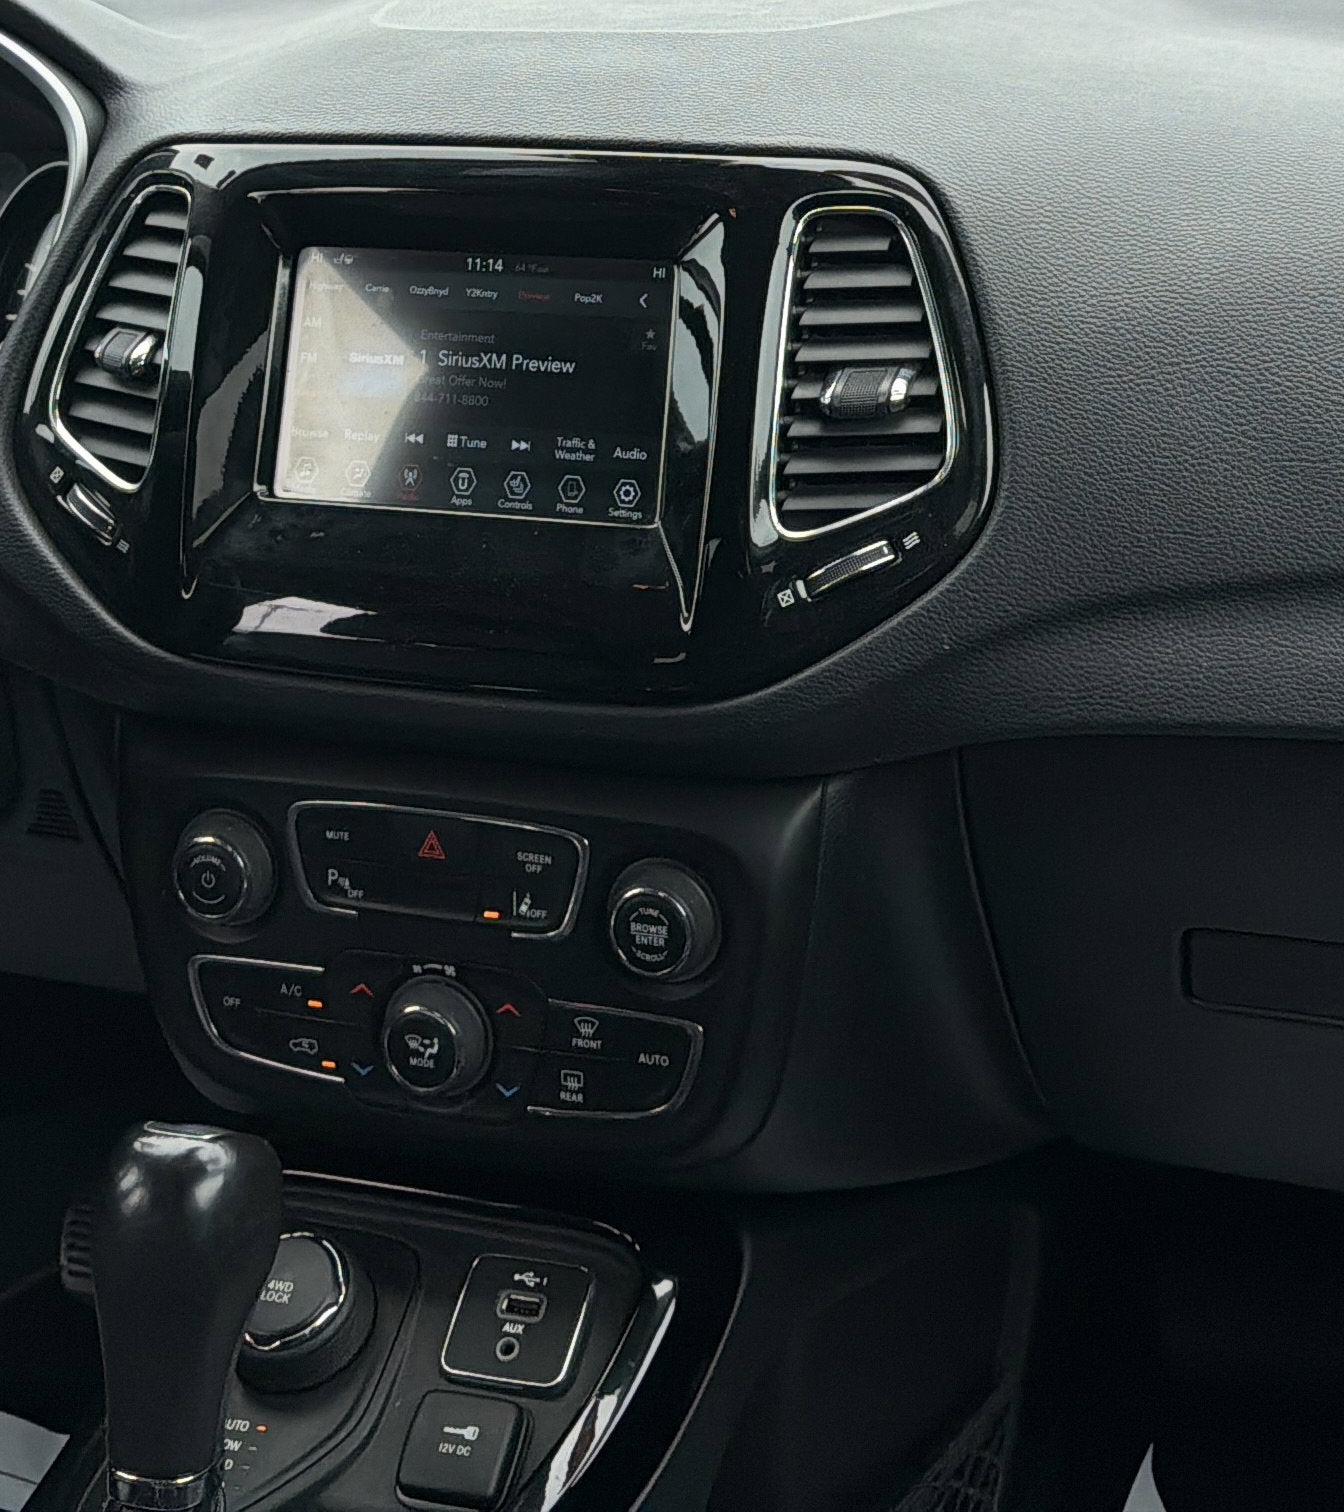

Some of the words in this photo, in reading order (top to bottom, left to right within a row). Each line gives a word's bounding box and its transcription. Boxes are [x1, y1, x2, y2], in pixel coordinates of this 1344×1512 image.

[466, 257, 504, 272] 11:14
[653, 267, 666, 279] HI
[574, 293, 603, 305] Pop2K
[303, 317, 322, 328] AM
[420, 329, 496, 344] Entertainment
[301, 352, 318, 363] FM
[348, 351, 405, 366] SiriusXM
[437, 350, 506, 369] SiriusXM
[512, 354, 576, 374] Preview
[448, 375, 476, 387] Offer
[344, 429, 380, 443] Replay
[460, 436, 488, 449] Tune
[556, 437, 586, 449] Traffic
[555, 450, 596, 462] Weather
[612, 447, 648, 461] Audio
[450, 496, 473, 507] Apps
[497, 498, 533, 511] Controls
[556, 503, 584, 514] Phone
[608, 507, 643, 521] Settings
[325, 830, 349, 842] MUTE
[516, 851, 552, 866] SCREEN
[524, 863, 543, 873] OFF
[348, 889, 364, 899] OFF
[530, 909, 547, 919] OFF
[638, 907, 660, 918] TUNE
[630, 922, 669, 937] BROWSE
[634, 934, 665, 947] ENTER
[280, 983, 302, 997] A/C
[222, 996, 241, 1008] OFF
[571, 1038, 602, 1050] FRONT
[409, 1057, 435, 1069] MODE
[638, 1053, 670, 1068] AUTO
[560, 1091, 584, 1103] REAR
[265, 1279, 294, 1293] 4WD
[259, 1289, 292, 1304] LOCK
[502, 1322, 524, 1335] AUX
[225, 1418, 250, 1432] UTO
[438, 1443, 456, 1456] 12V
[456, 1445, 471, 1457] DC
